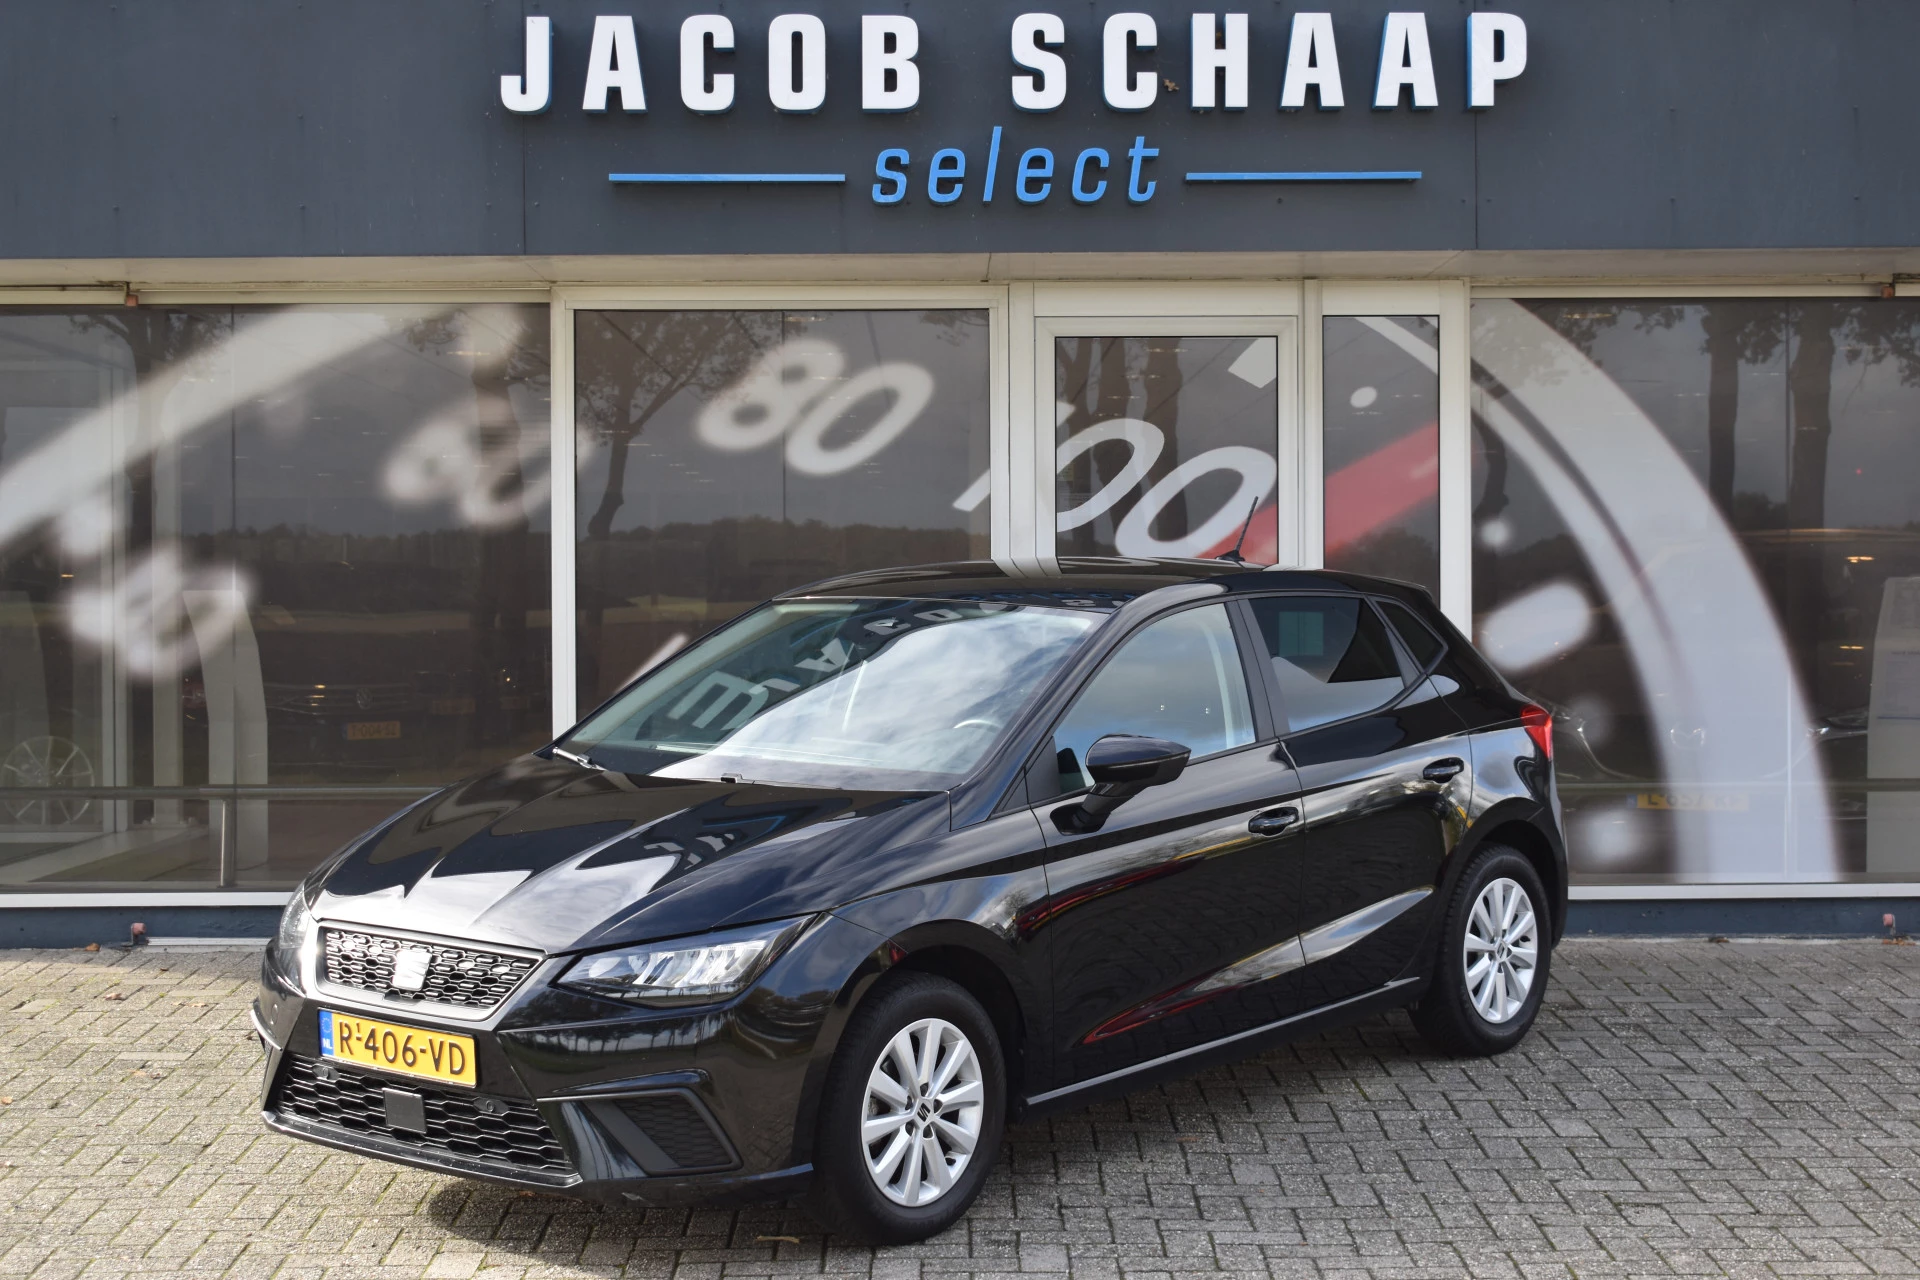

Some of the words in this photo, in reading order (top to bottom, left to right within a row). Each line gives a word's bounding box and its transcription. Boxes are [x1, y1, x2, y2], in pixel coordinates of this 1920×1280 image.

[500, 13, 921, 115] JACOB
[1010, 11, 1528, 113] SCHAAP
[871, 126, 1160, 204] select
[696, 339, 934, 476] 80
[322, 1037, 333, 1050] NL
[338, 1020, 466, 1075] R-406-VD
